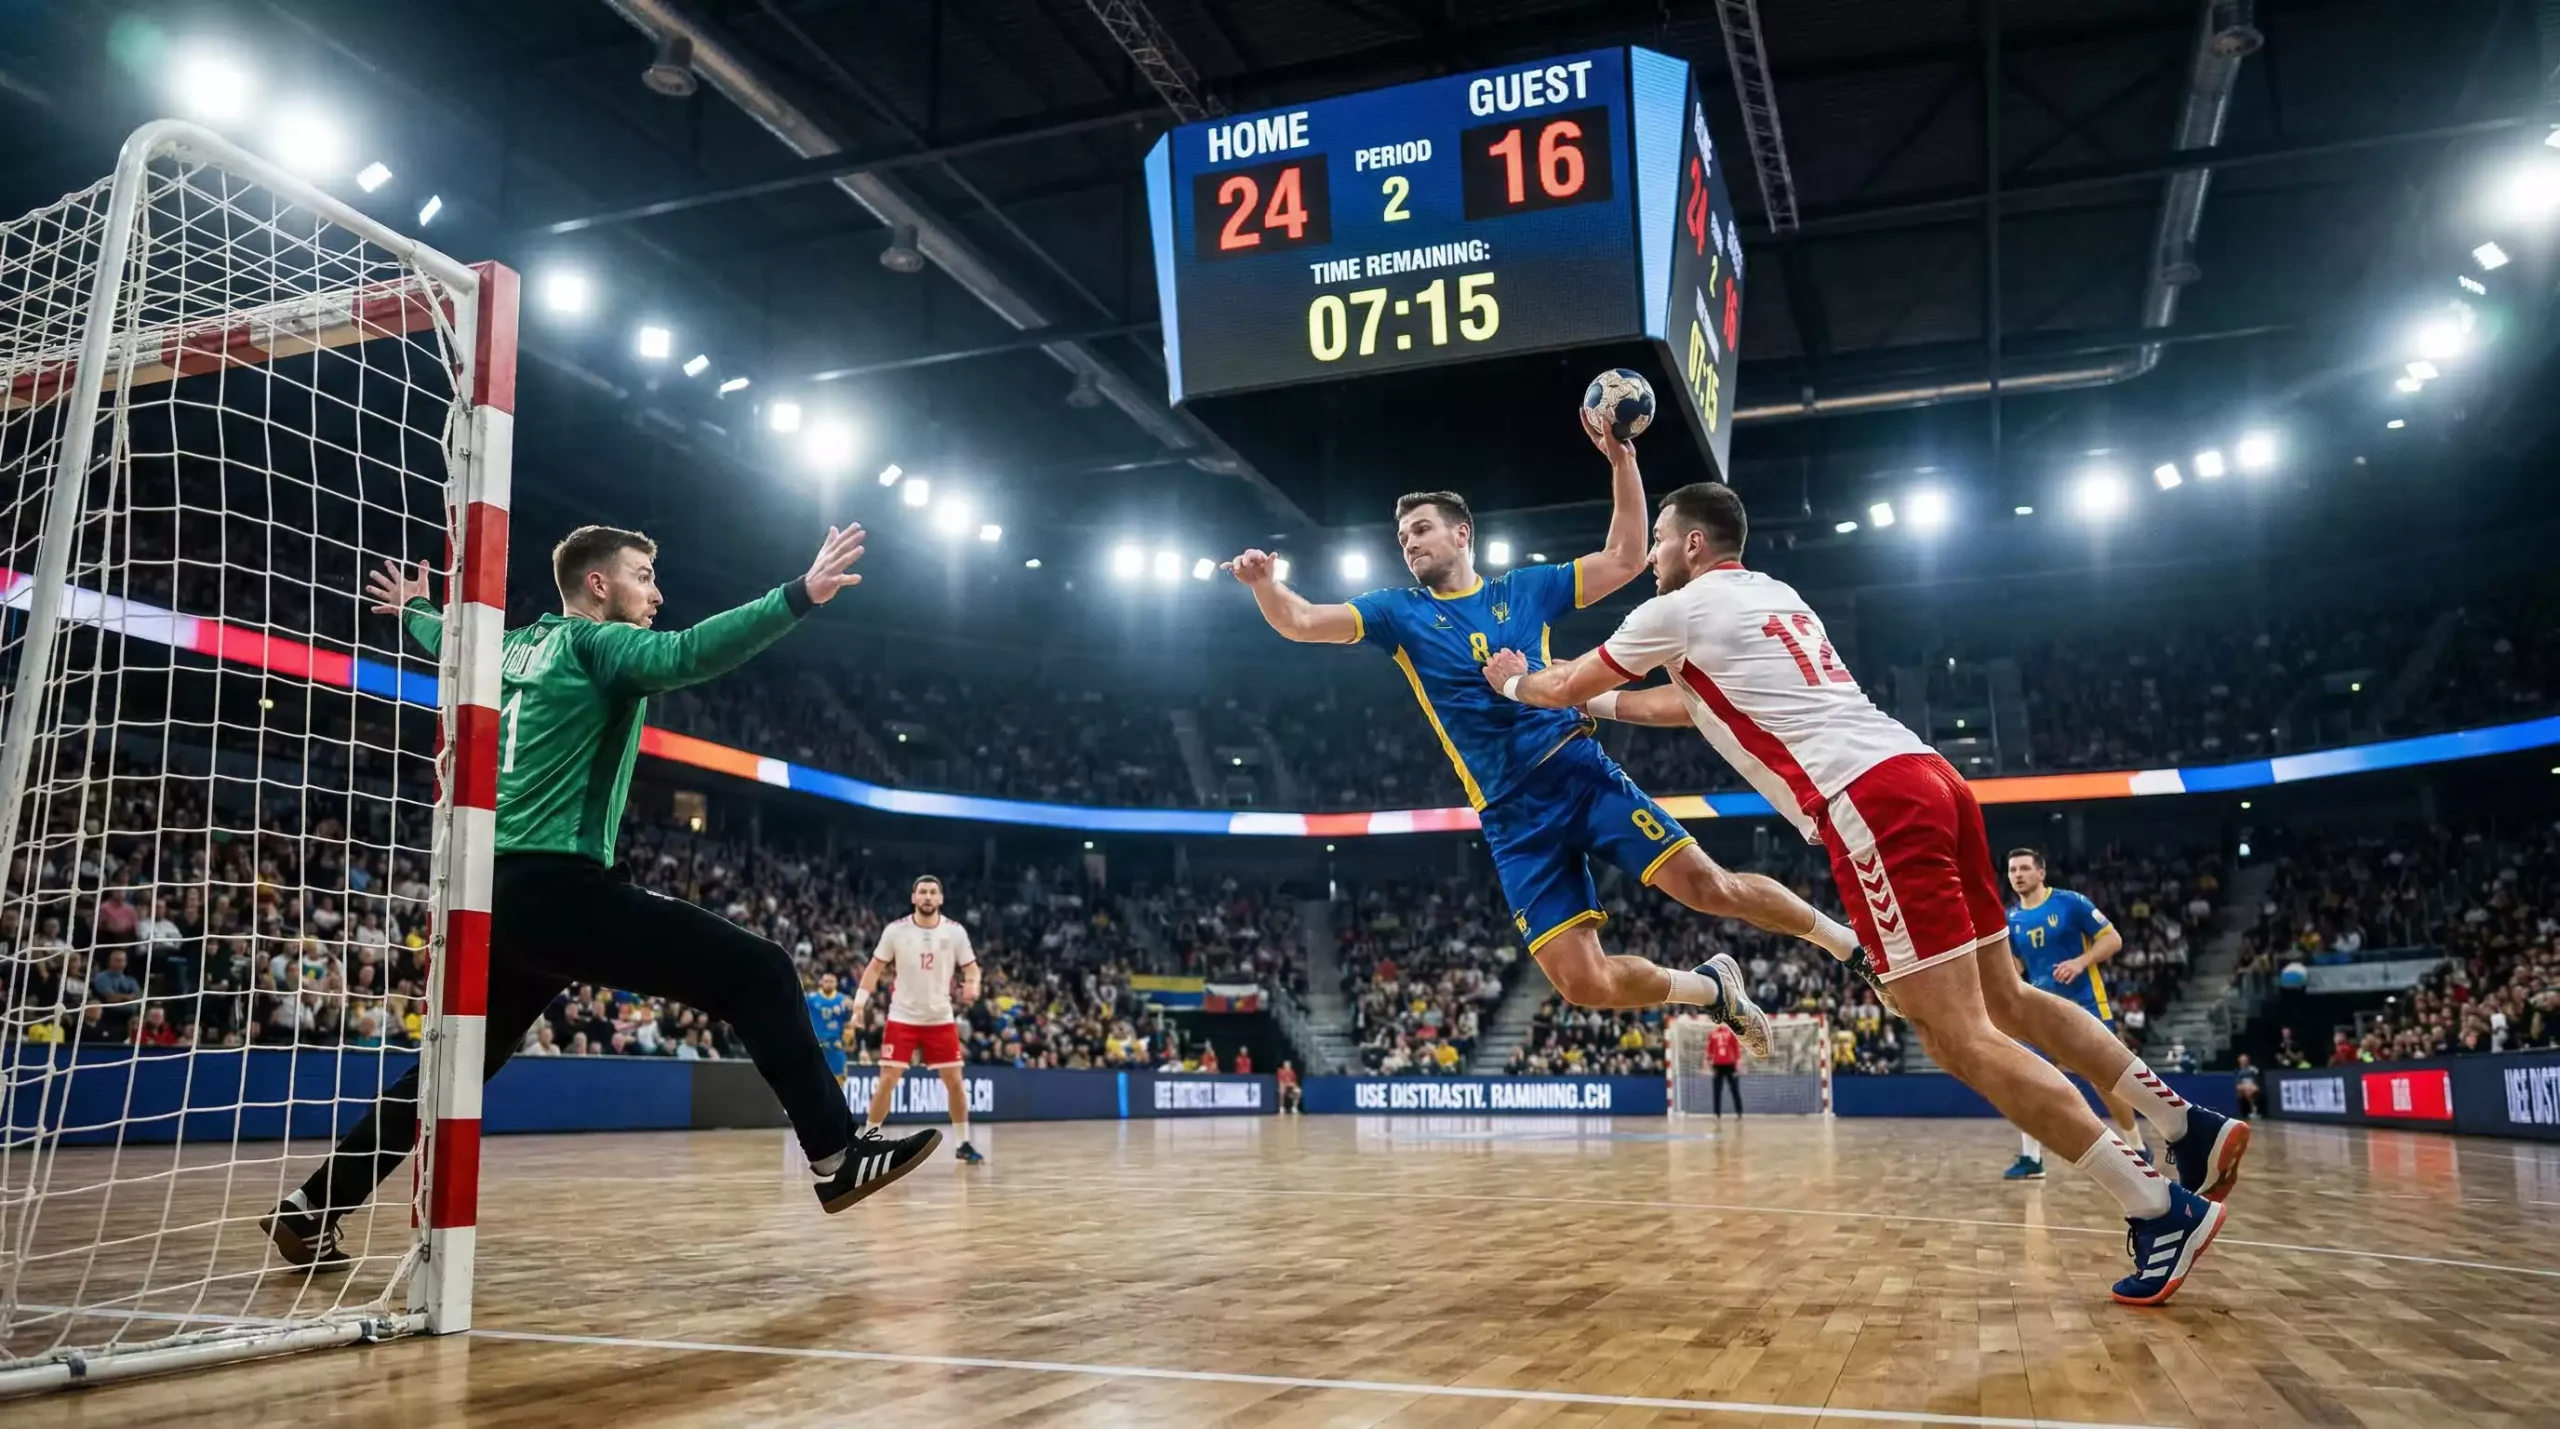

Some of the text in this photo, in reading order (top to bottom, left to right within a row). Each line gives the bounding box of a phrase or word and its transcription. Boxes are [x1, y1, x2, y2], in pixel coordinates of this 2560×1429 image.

[1469, 60, 1593, 116] GUEST
[1208, 111, 1309, 163] HOME
[1355, 139, 1432, 172] PERIOD
[1488, 120, 1586, 204] 16
[1218, 167, 1309, 250] 24
[1382, 175, 1411, 222] 2
[1686, 156, 1708, 256] 24
[1310, 239, 1491, 284] TIME REMAINING:
[1309, 272, 1500, 362] 07:15
[1723, 276, 1739, 353] 16
[1688, 319, 1720, 433] 07:15
[1469, 632, 1491, 663] 8
[1761, 614, 1854, 687] 12
[501, 688, 523, 773] 1
[1631, 808, 1666, 841] 8
[920, 953, 935, 971] 12
[1355, 1082, 1388, 1108] USE
